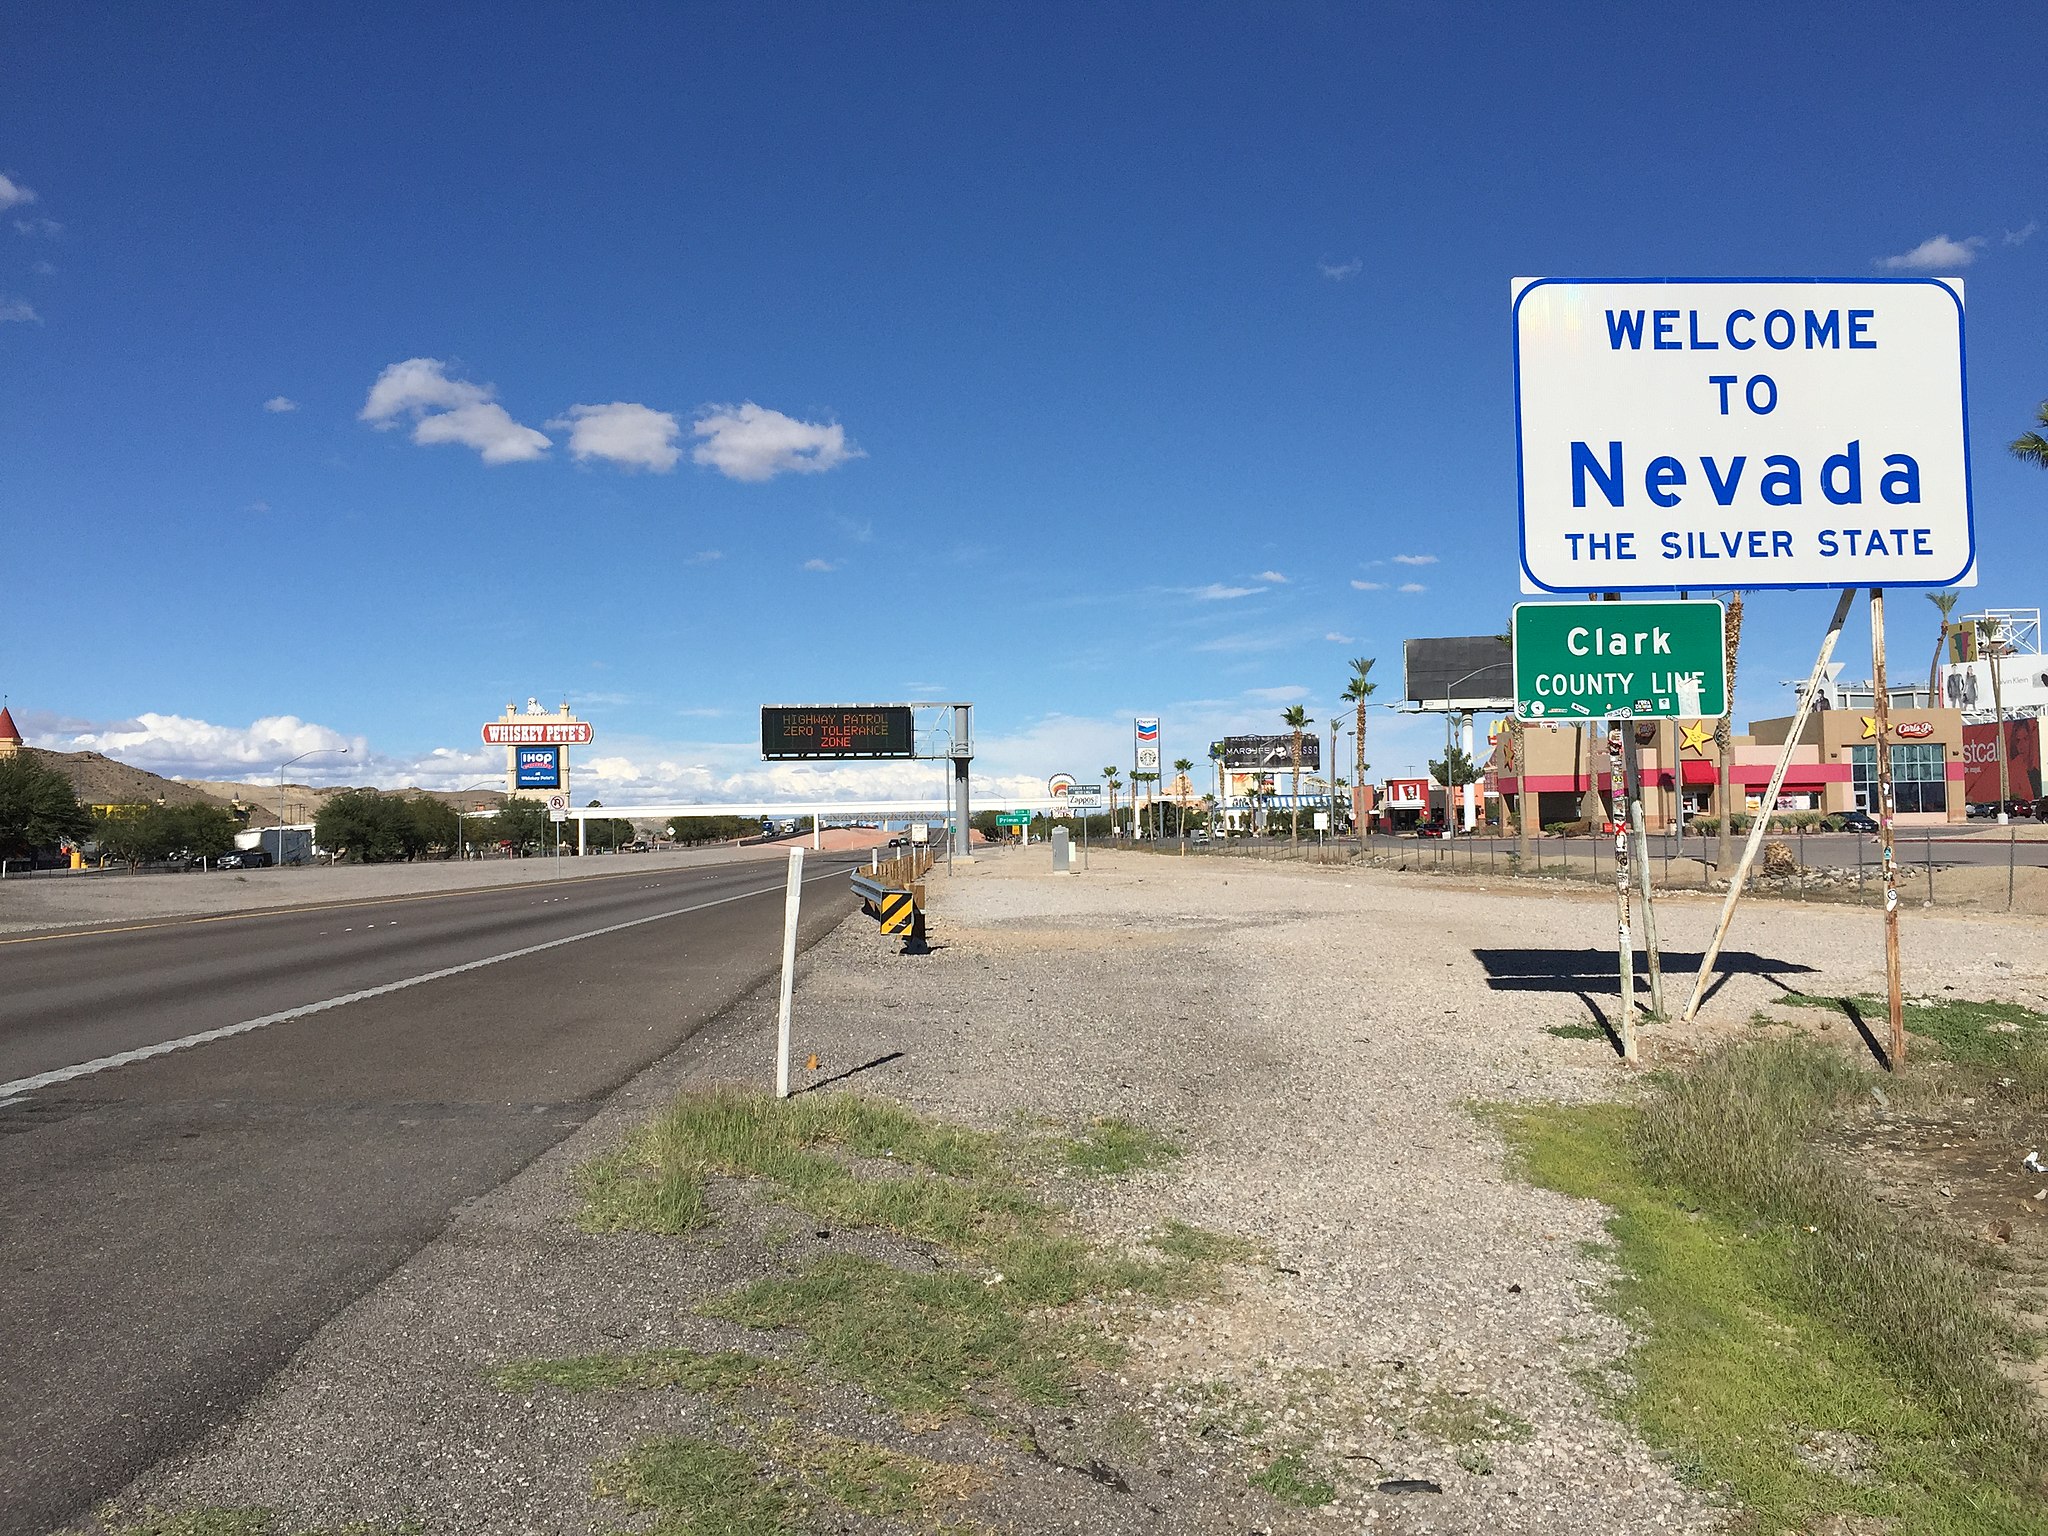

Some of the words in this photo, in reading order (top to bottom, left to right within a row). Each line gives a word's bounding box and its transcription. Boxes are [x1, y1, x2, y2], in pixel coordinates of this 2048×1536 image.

[1605, 309, 1877, 350] WELCOME
[1709, 374, 1778, 415] TO
[1571, 439, 1921, 508] Nevada
[1565, 533, 1637, 561] THE
[1661, 531, 1793, 559] SILVER
[1818, 529, 1933, 557] STATE
[1567, 626, 1671, 656] Clark
[1535, 672, 1634, 696] COUNTY
[1652, 671, 1706, 695] LINE
[783, 714, 835, 724] HIGHWAY
[843, 714, 888, 724] PATROL
[783, 726, 813, 736] ZERO
[821, 725, 888, 736] TOLERANCE
[489, 725, 543, 741] WHISKEY
[546, 725, 585, 741] PETE'S
[821, 737, 851, 747] ZONE
[1963, 735, 2000, 763] stcal
[1069, 795, 1095, 805] Zappos
